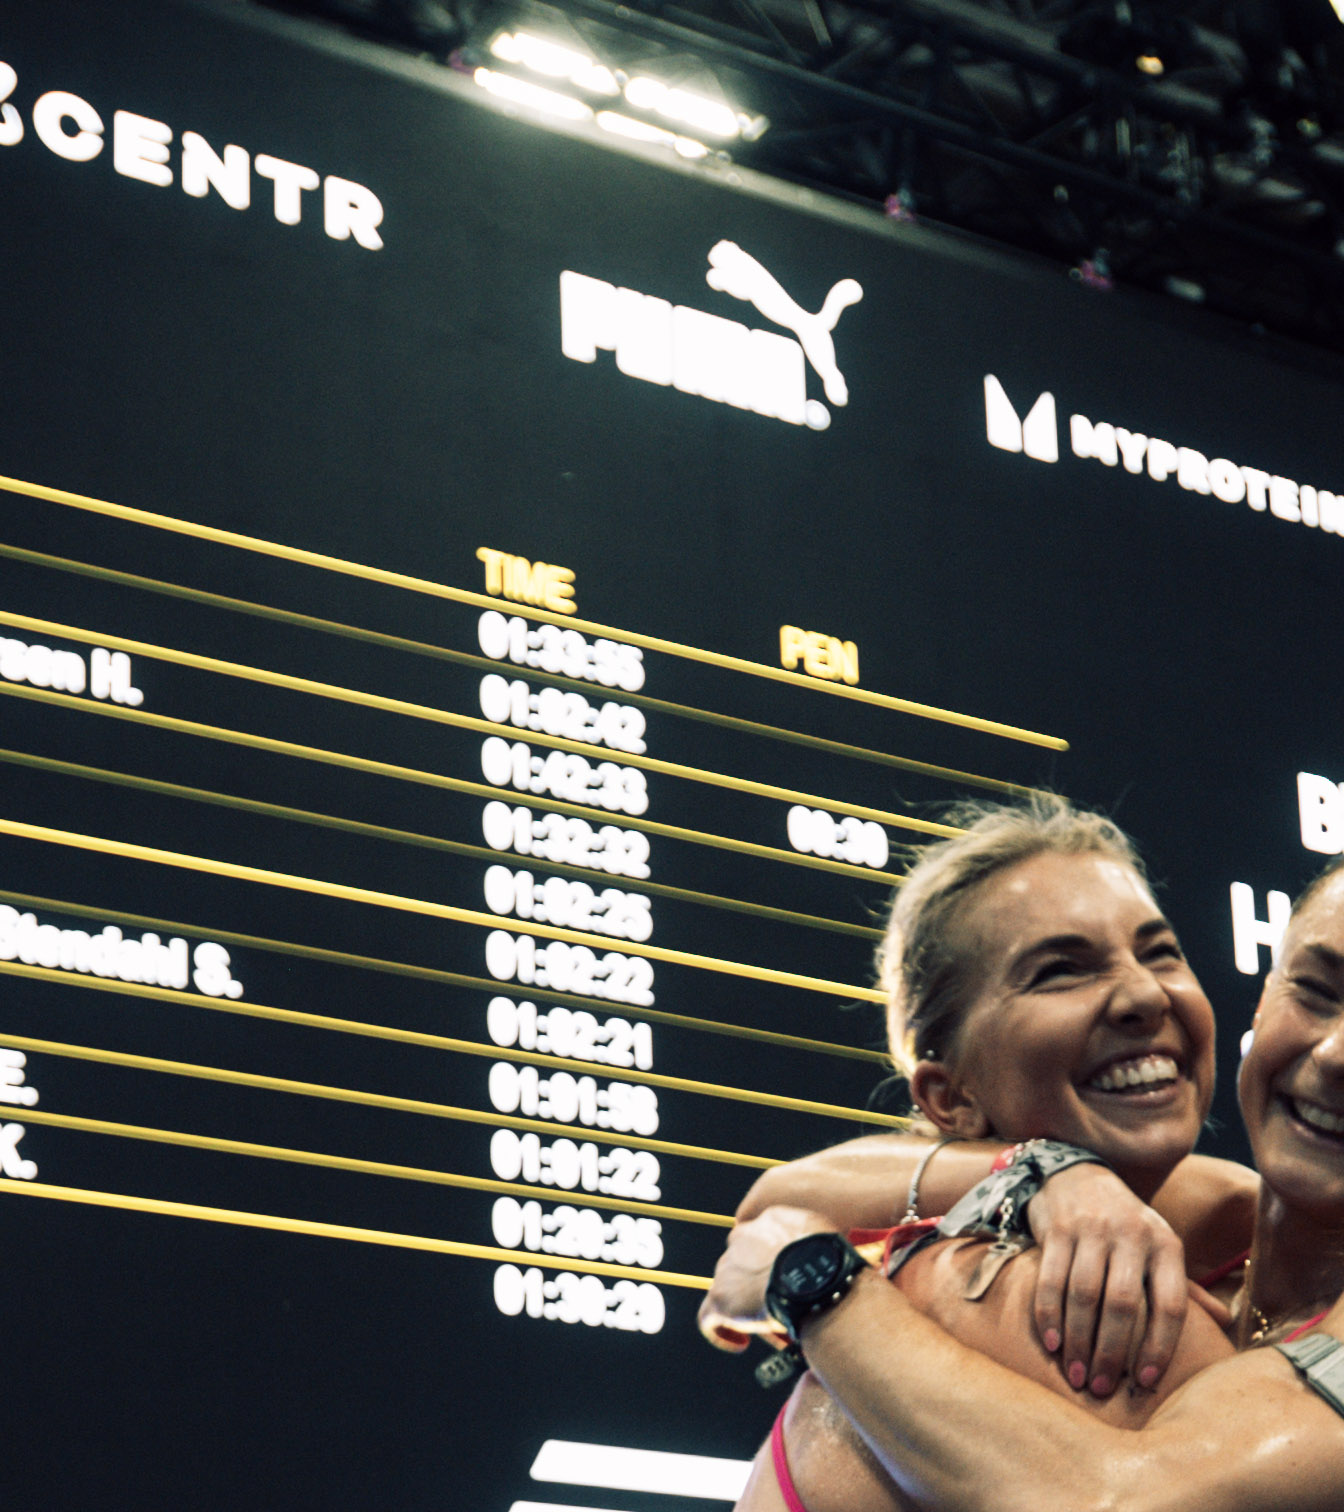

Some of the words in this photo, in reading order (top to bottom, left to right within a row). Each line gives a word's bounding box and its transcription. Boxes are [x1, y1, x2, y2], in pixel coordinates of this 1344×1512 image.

[33, 91, 385, 250] CENTR
[476, 546, 577, 615] TIME
[779, 624, 860, 685] PEN
[90, 647, 144, 706] H.
[192, 941, 244, 999] S.
